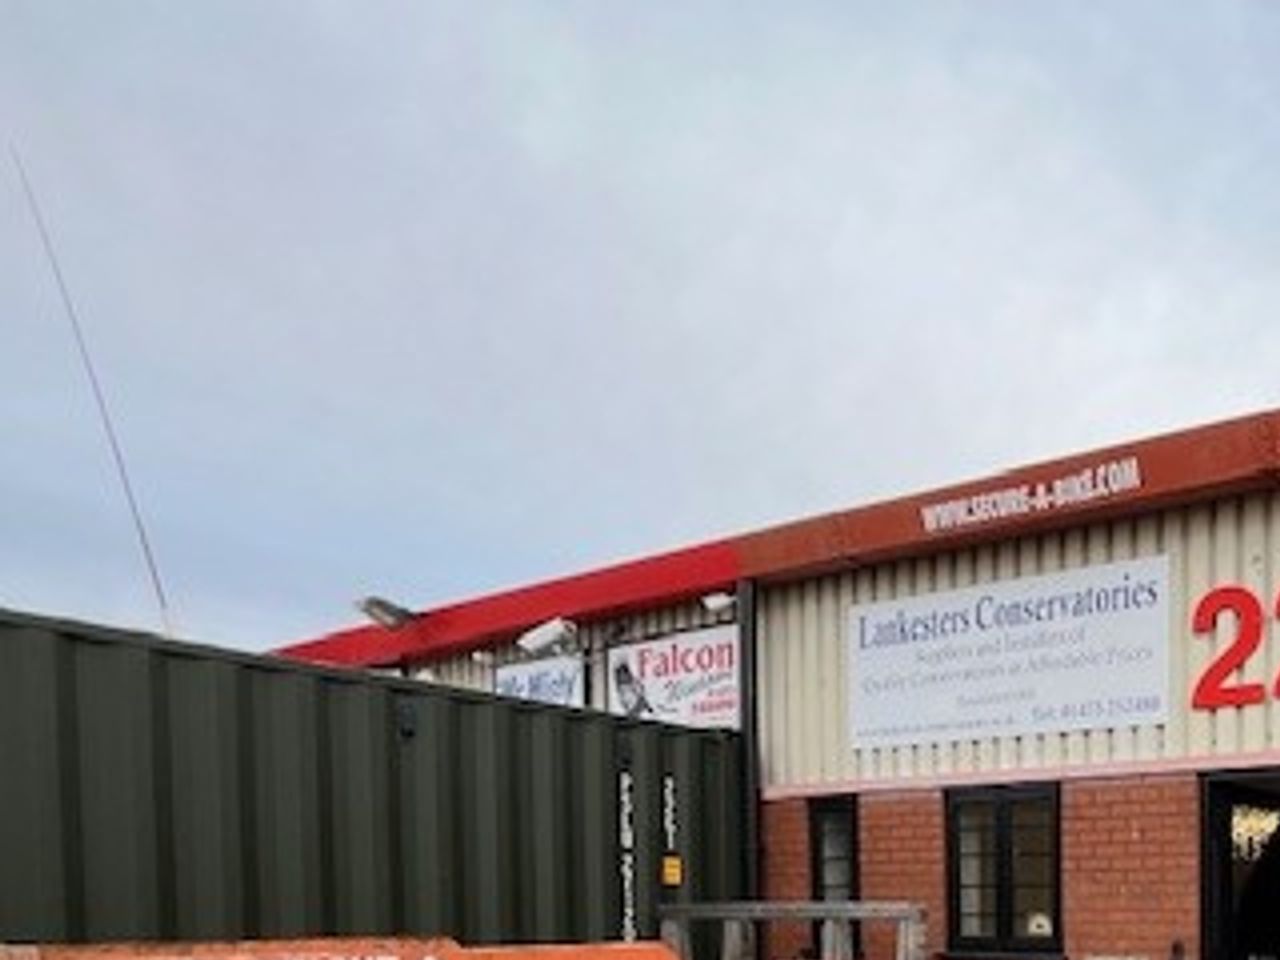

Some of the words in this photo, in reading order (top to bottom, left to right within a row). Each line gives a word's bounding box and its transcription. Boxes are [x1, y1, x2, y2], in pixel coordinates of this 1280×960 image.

[859, 608, 970, 650] Lankesters
[975, 573, 1159, 631] Conservatories
[637, 643, 734, 679] Falcon
